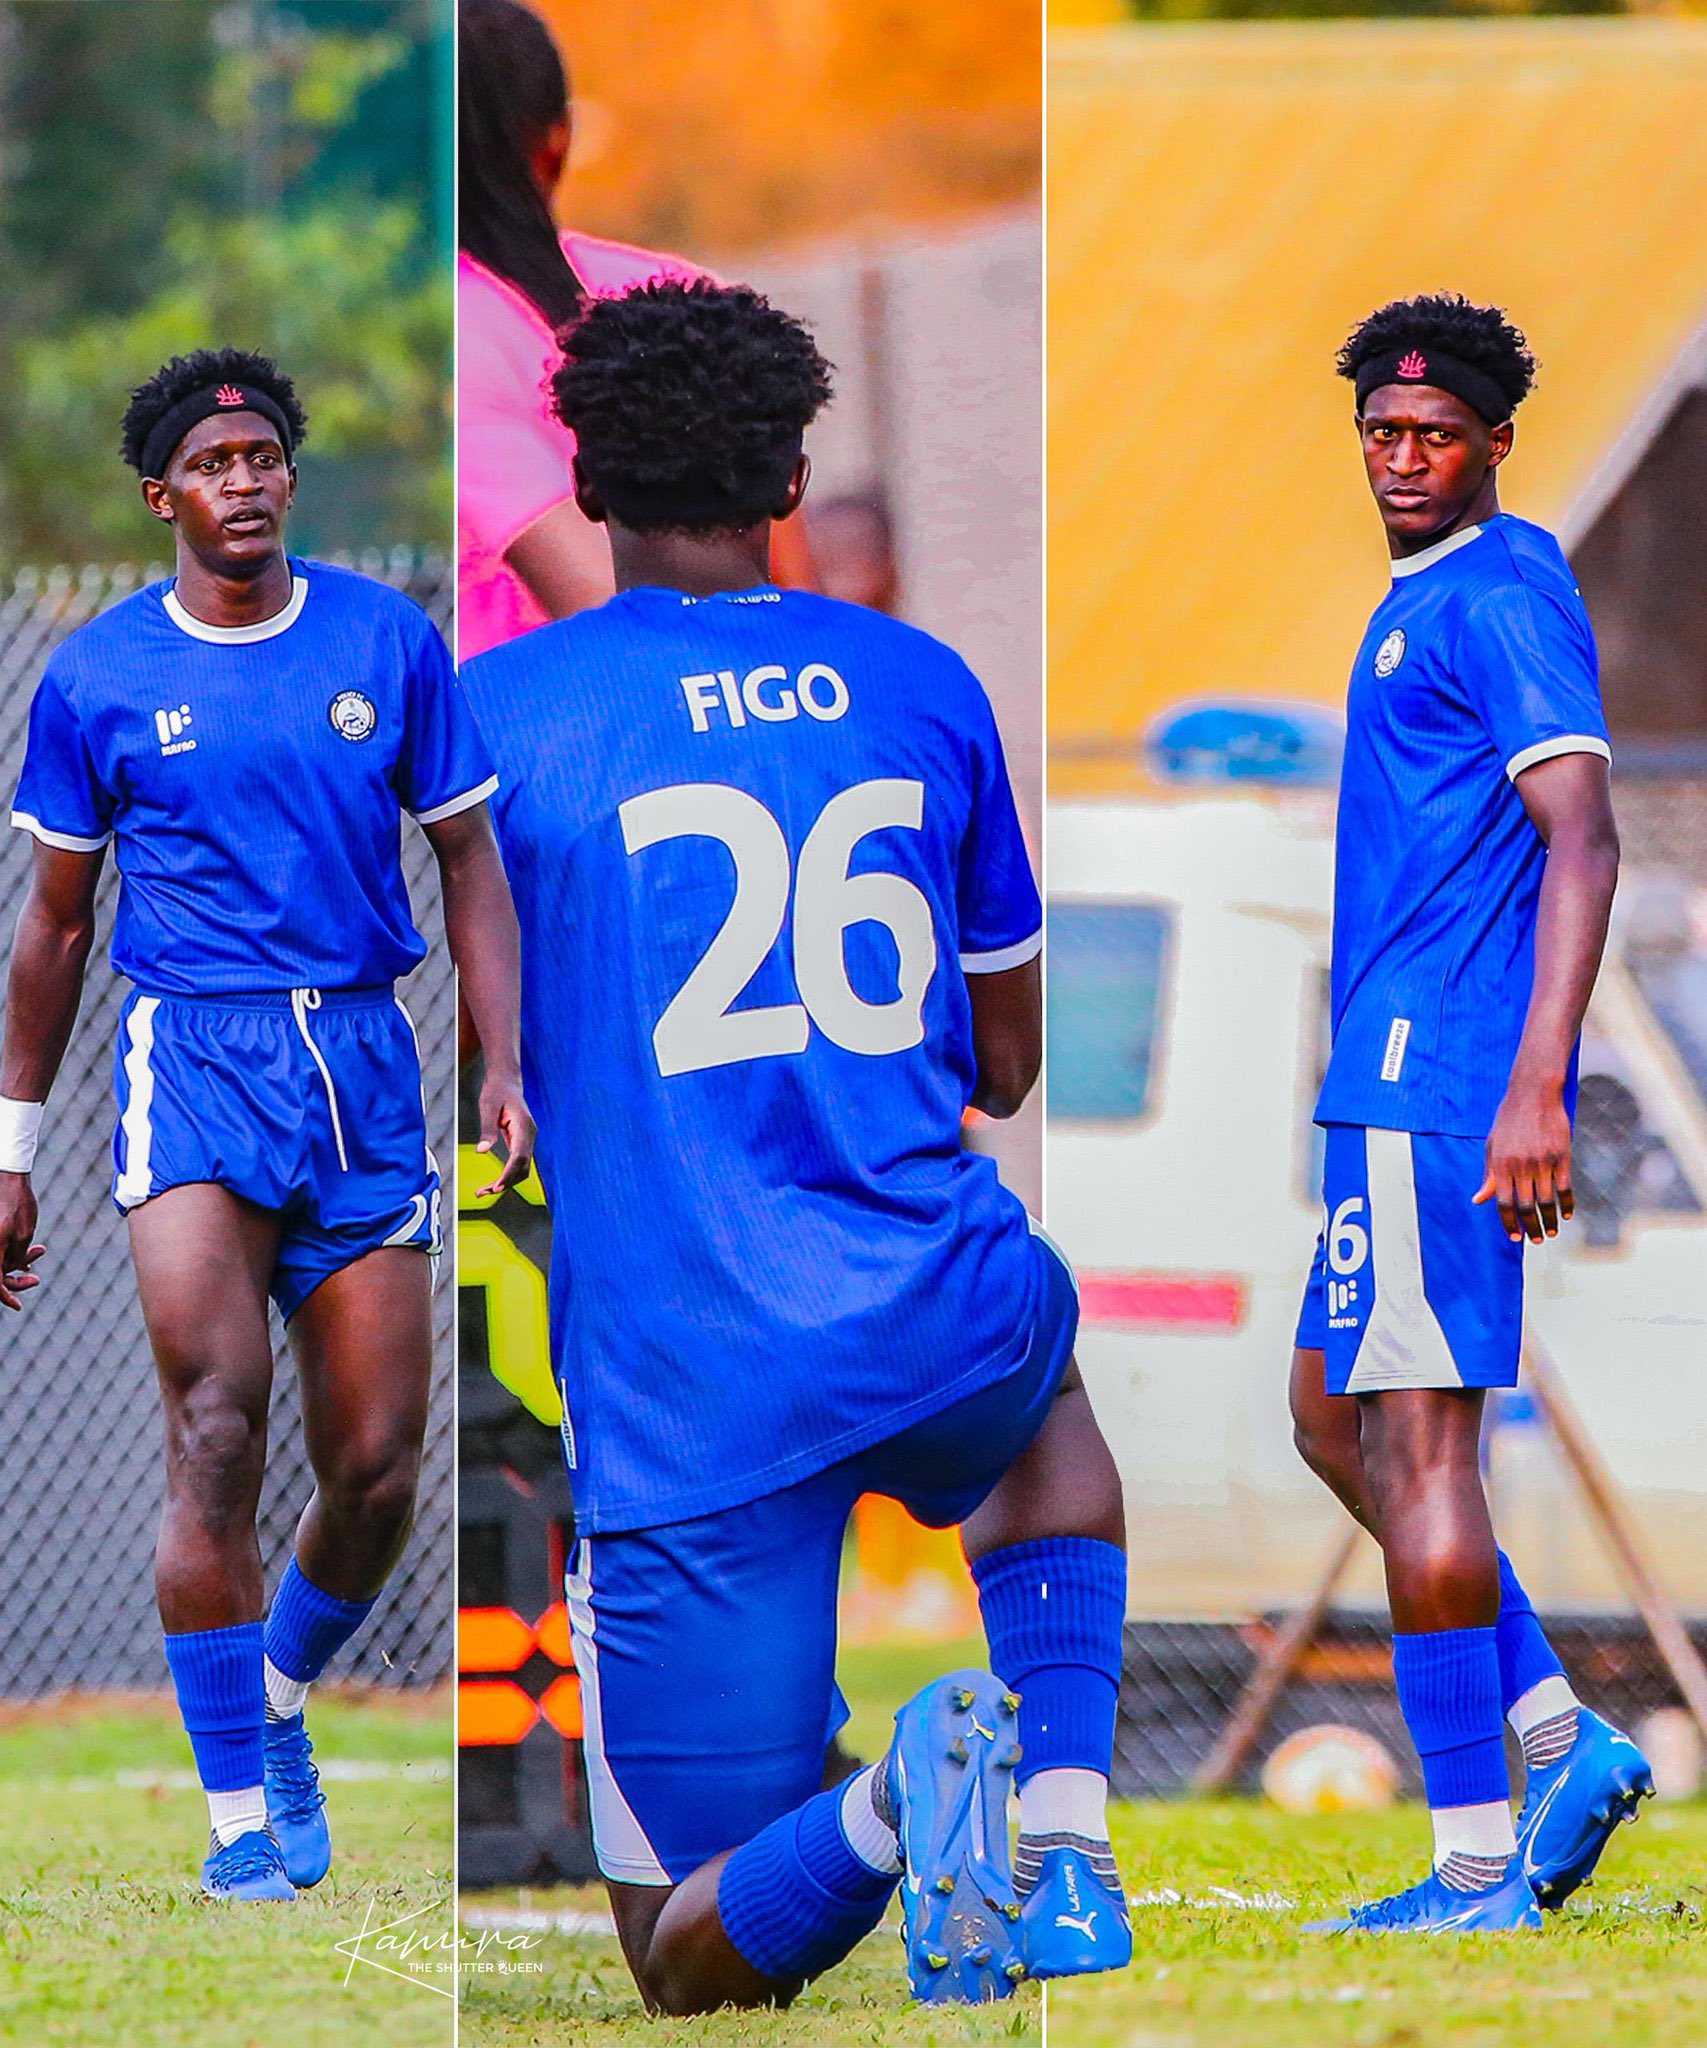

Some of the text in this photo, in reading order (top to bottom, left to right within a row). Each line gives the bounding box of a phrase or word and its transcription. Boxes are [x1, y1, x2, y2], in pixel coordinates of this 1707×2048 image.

[680, 663, 850, 733] FIGO
[618, 778, 937, 1078] 26
[1385, 1022, 1405, 1078] coolbreeze
